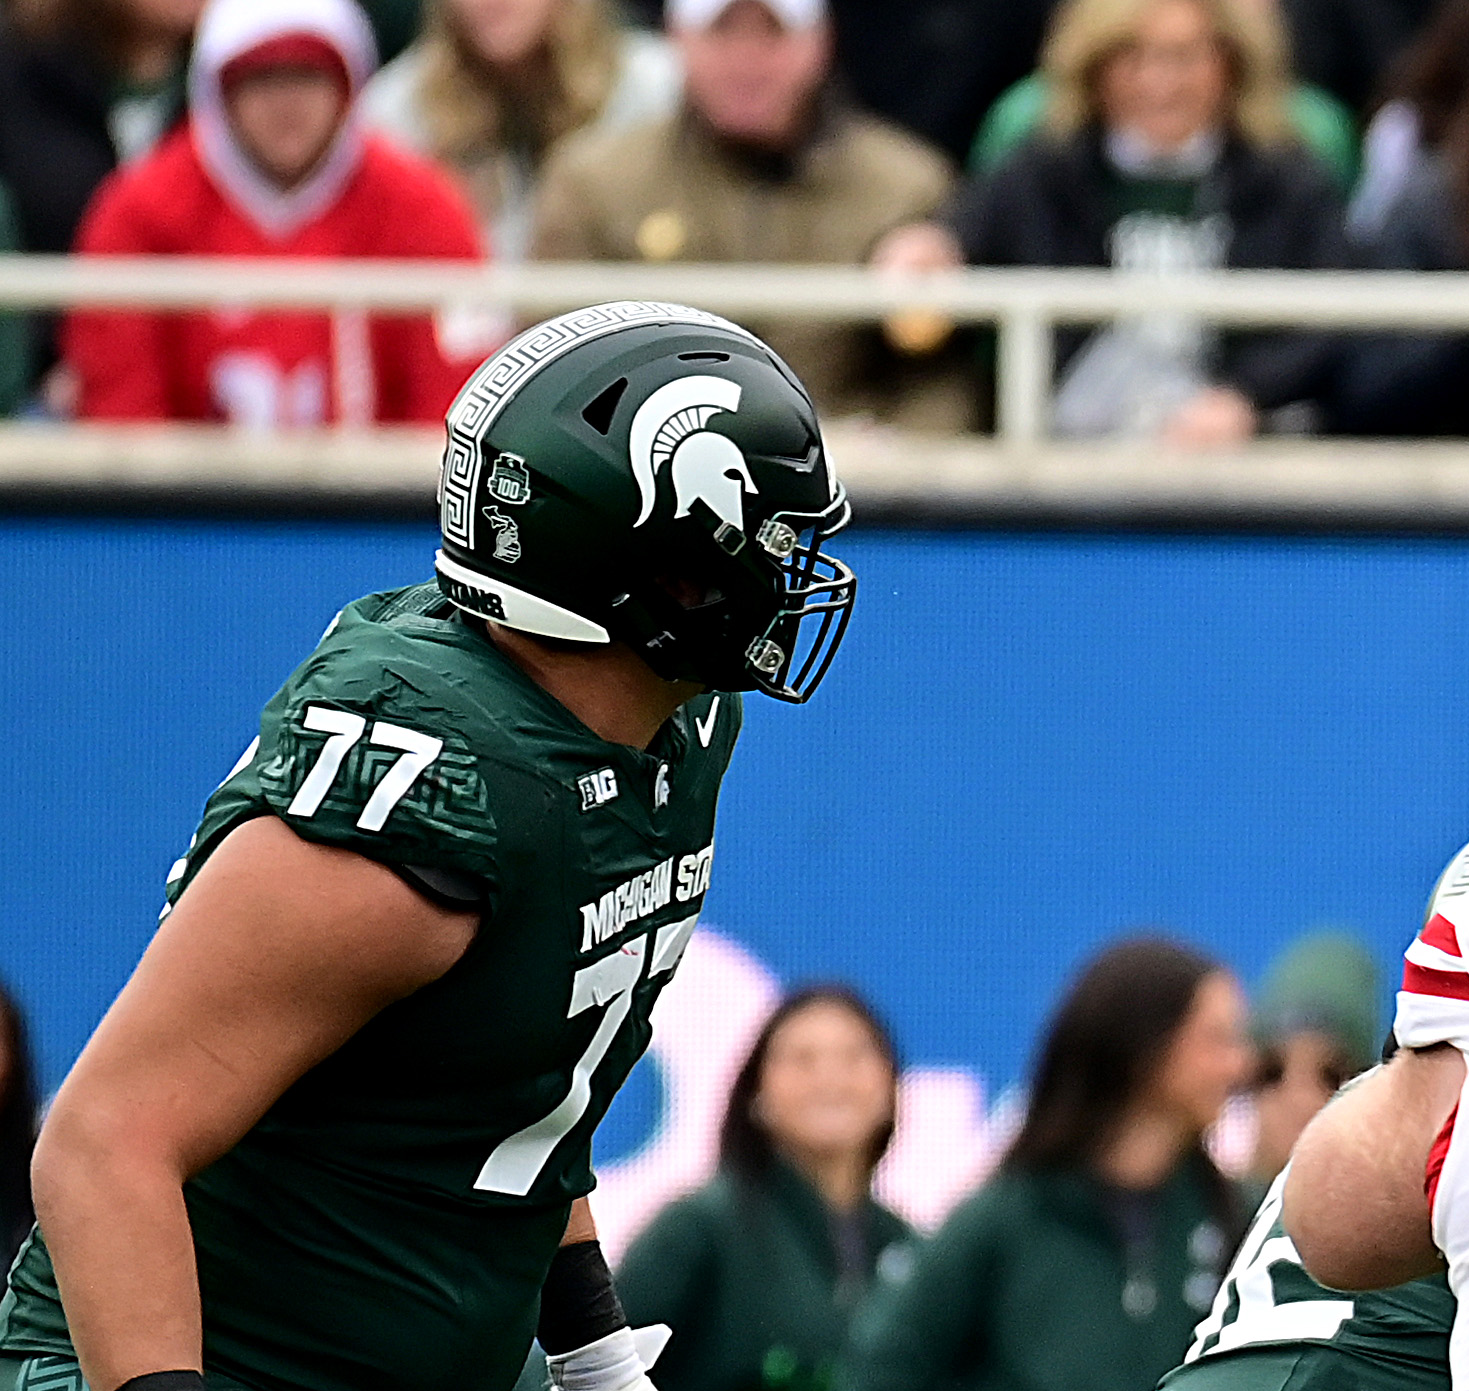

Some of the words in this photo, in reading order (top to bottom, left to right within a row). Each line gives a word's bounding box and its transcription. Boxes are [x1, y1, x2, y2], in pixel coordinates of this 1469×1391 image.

[497, 477, 520, 500] 100
[287, 706, 443, 831] 77
[580, 856, 675, 953] MICHIGAN
